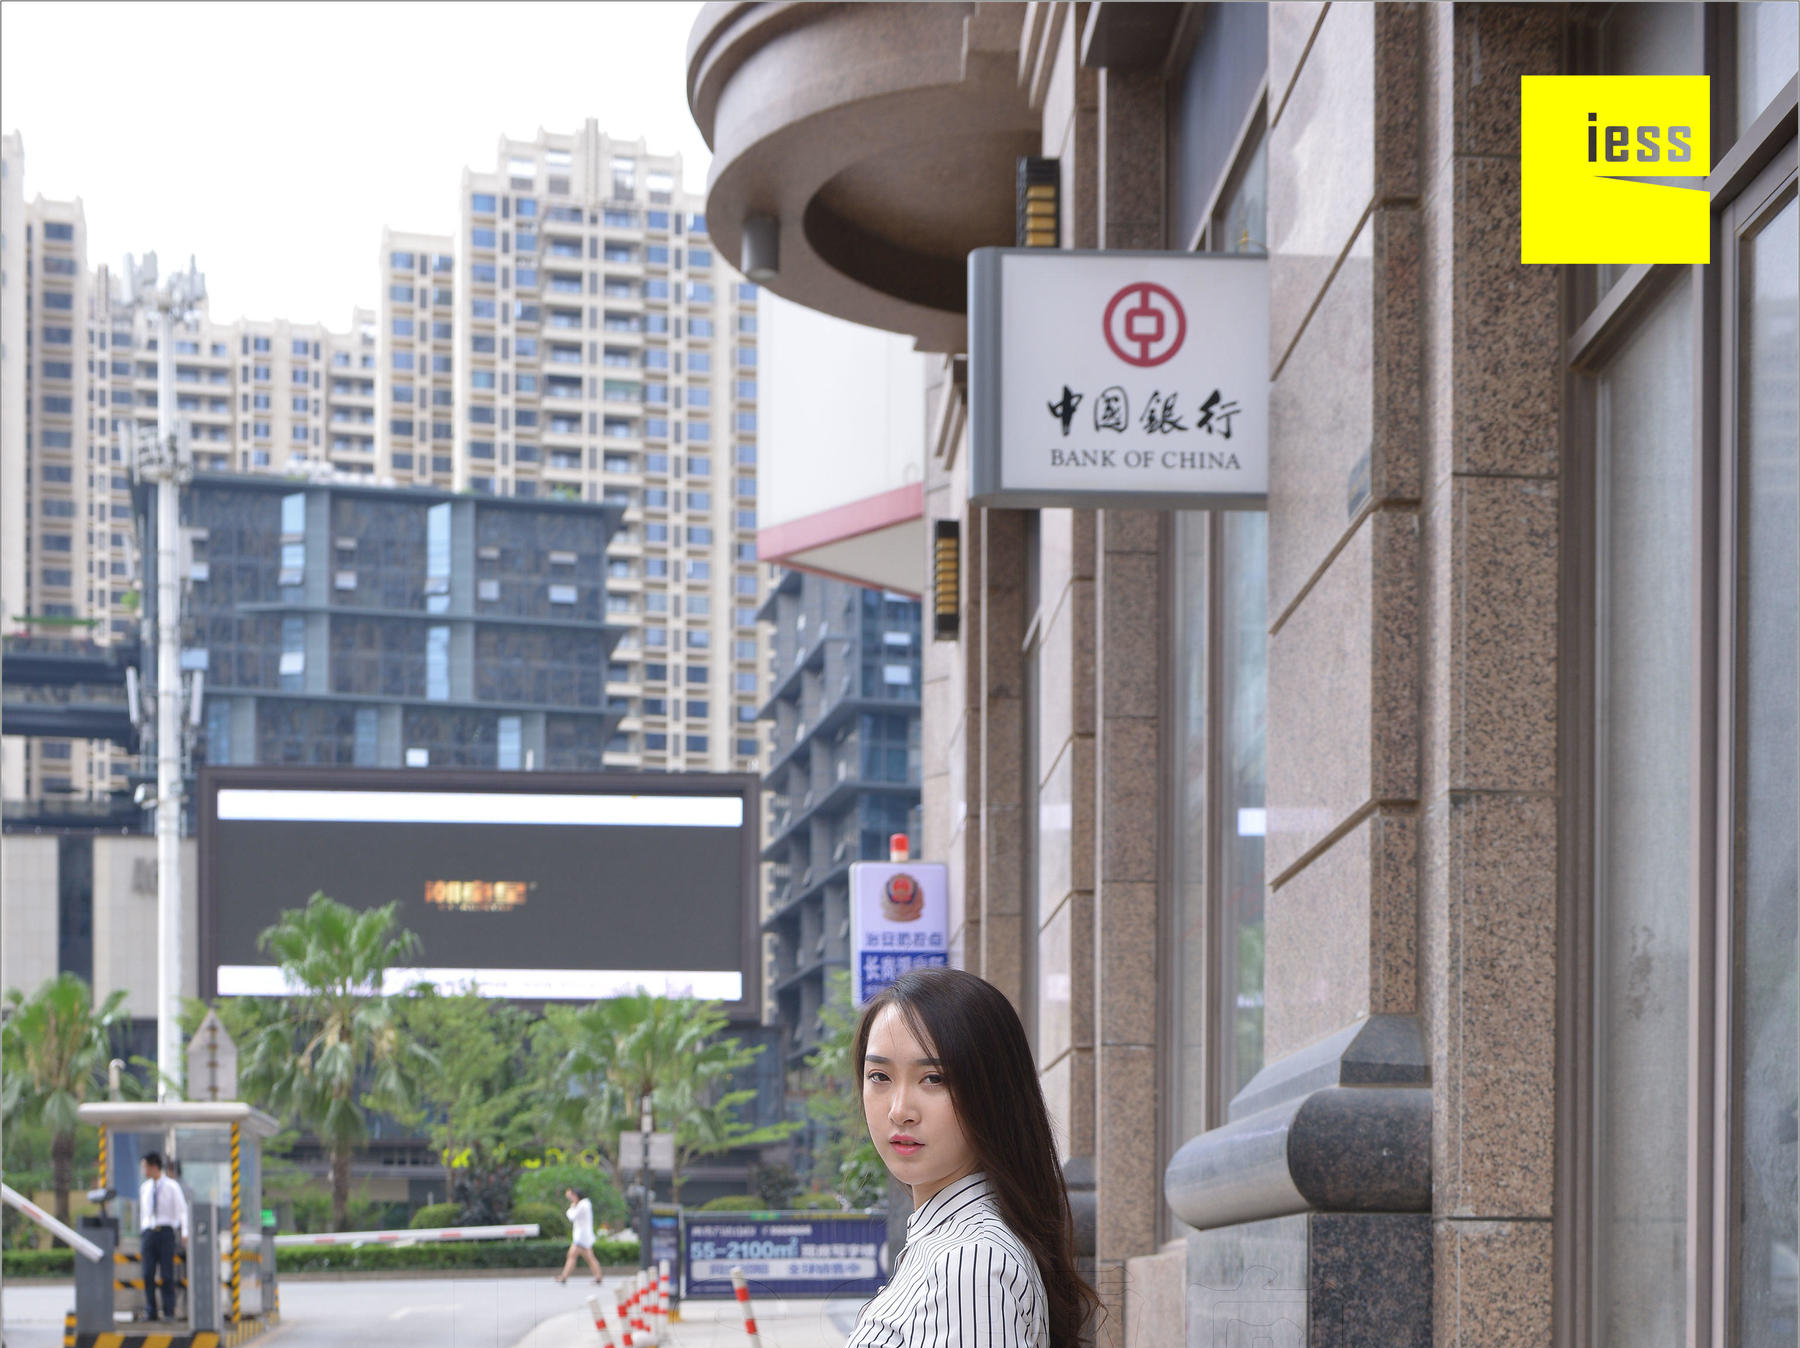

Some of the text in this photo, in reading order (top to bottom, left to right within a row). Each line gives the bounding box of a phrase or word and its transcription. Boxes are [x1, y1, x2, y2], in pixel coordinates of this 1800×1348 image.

[1050, 449, 1241, 470] BANK OF CHINA
